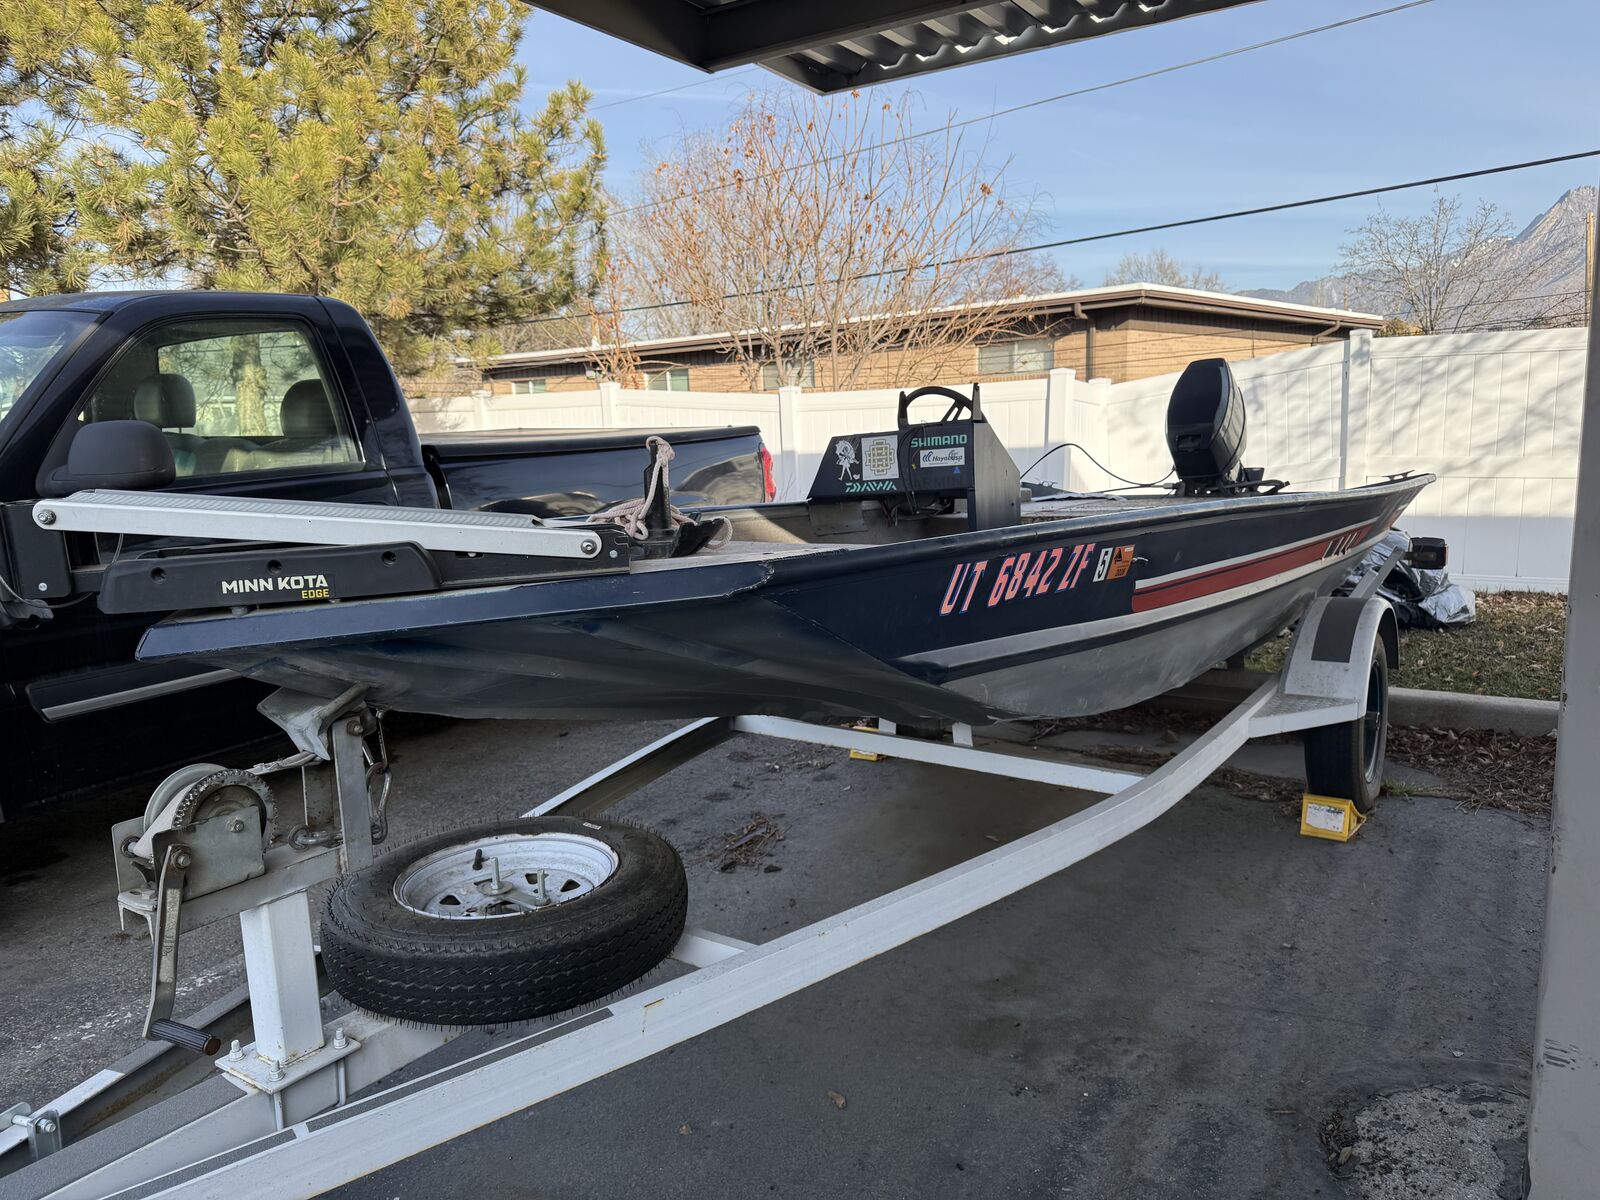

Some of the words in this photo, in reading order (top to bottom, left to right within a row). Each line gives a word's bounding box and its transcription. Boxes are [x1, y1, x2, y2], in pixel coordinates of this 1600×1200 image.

[911, 434, 967, 447] SHIMANO
[846, 481, 897, 492] DAIWA
[222, 578, 273, 594] MINN
[278, 574, 328, 590] KOTA
[939, 560, 988, 615] UT
[987, 547, 1063, 607] 6842
[1054, 543, 1096, 593] ZF
[301, 589, 329, 599] EDGE
